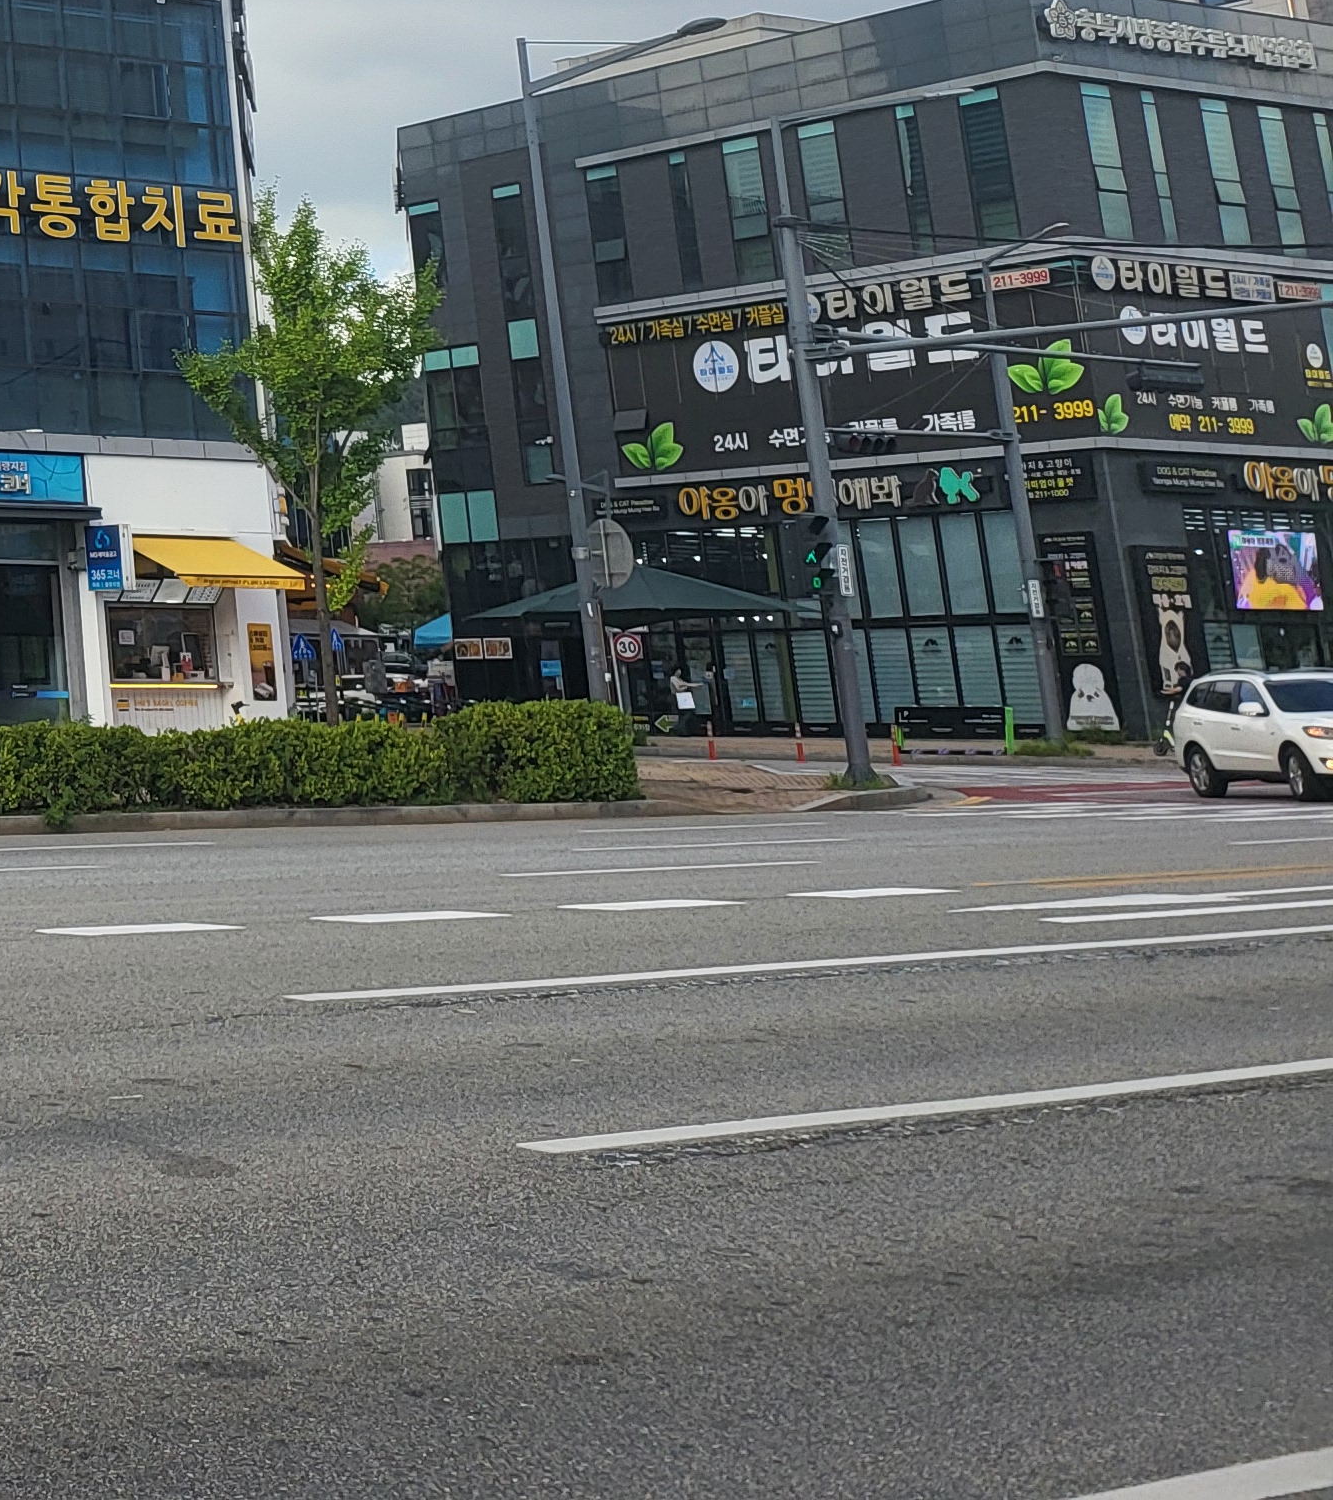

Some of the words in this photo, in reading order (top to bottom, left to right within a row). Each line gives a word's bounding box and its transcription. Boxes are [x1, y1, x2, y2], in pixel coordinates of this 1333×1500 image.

[825, 272, 972, 320] 타이월드
[993, 269, 1049, 288] 211-3999
[1118, 259, 1228, 298] 타이월드
[610, 324, 637, 345] 24시
[649, 317, 684, 341] 가족실
[696, 311, 734, 335] 수면실
[745, 303, 785, 328] 커플실
[1054, 400, 1094, 420] 3999
[714, 432, 748, 452] 24시
[922, 411, 976, 433] 가족룸
[1244, 461, 1321, 502] 야옹아
[679, 484, 769, 520] 야옹아
[619, 641, 637, 654] 30
